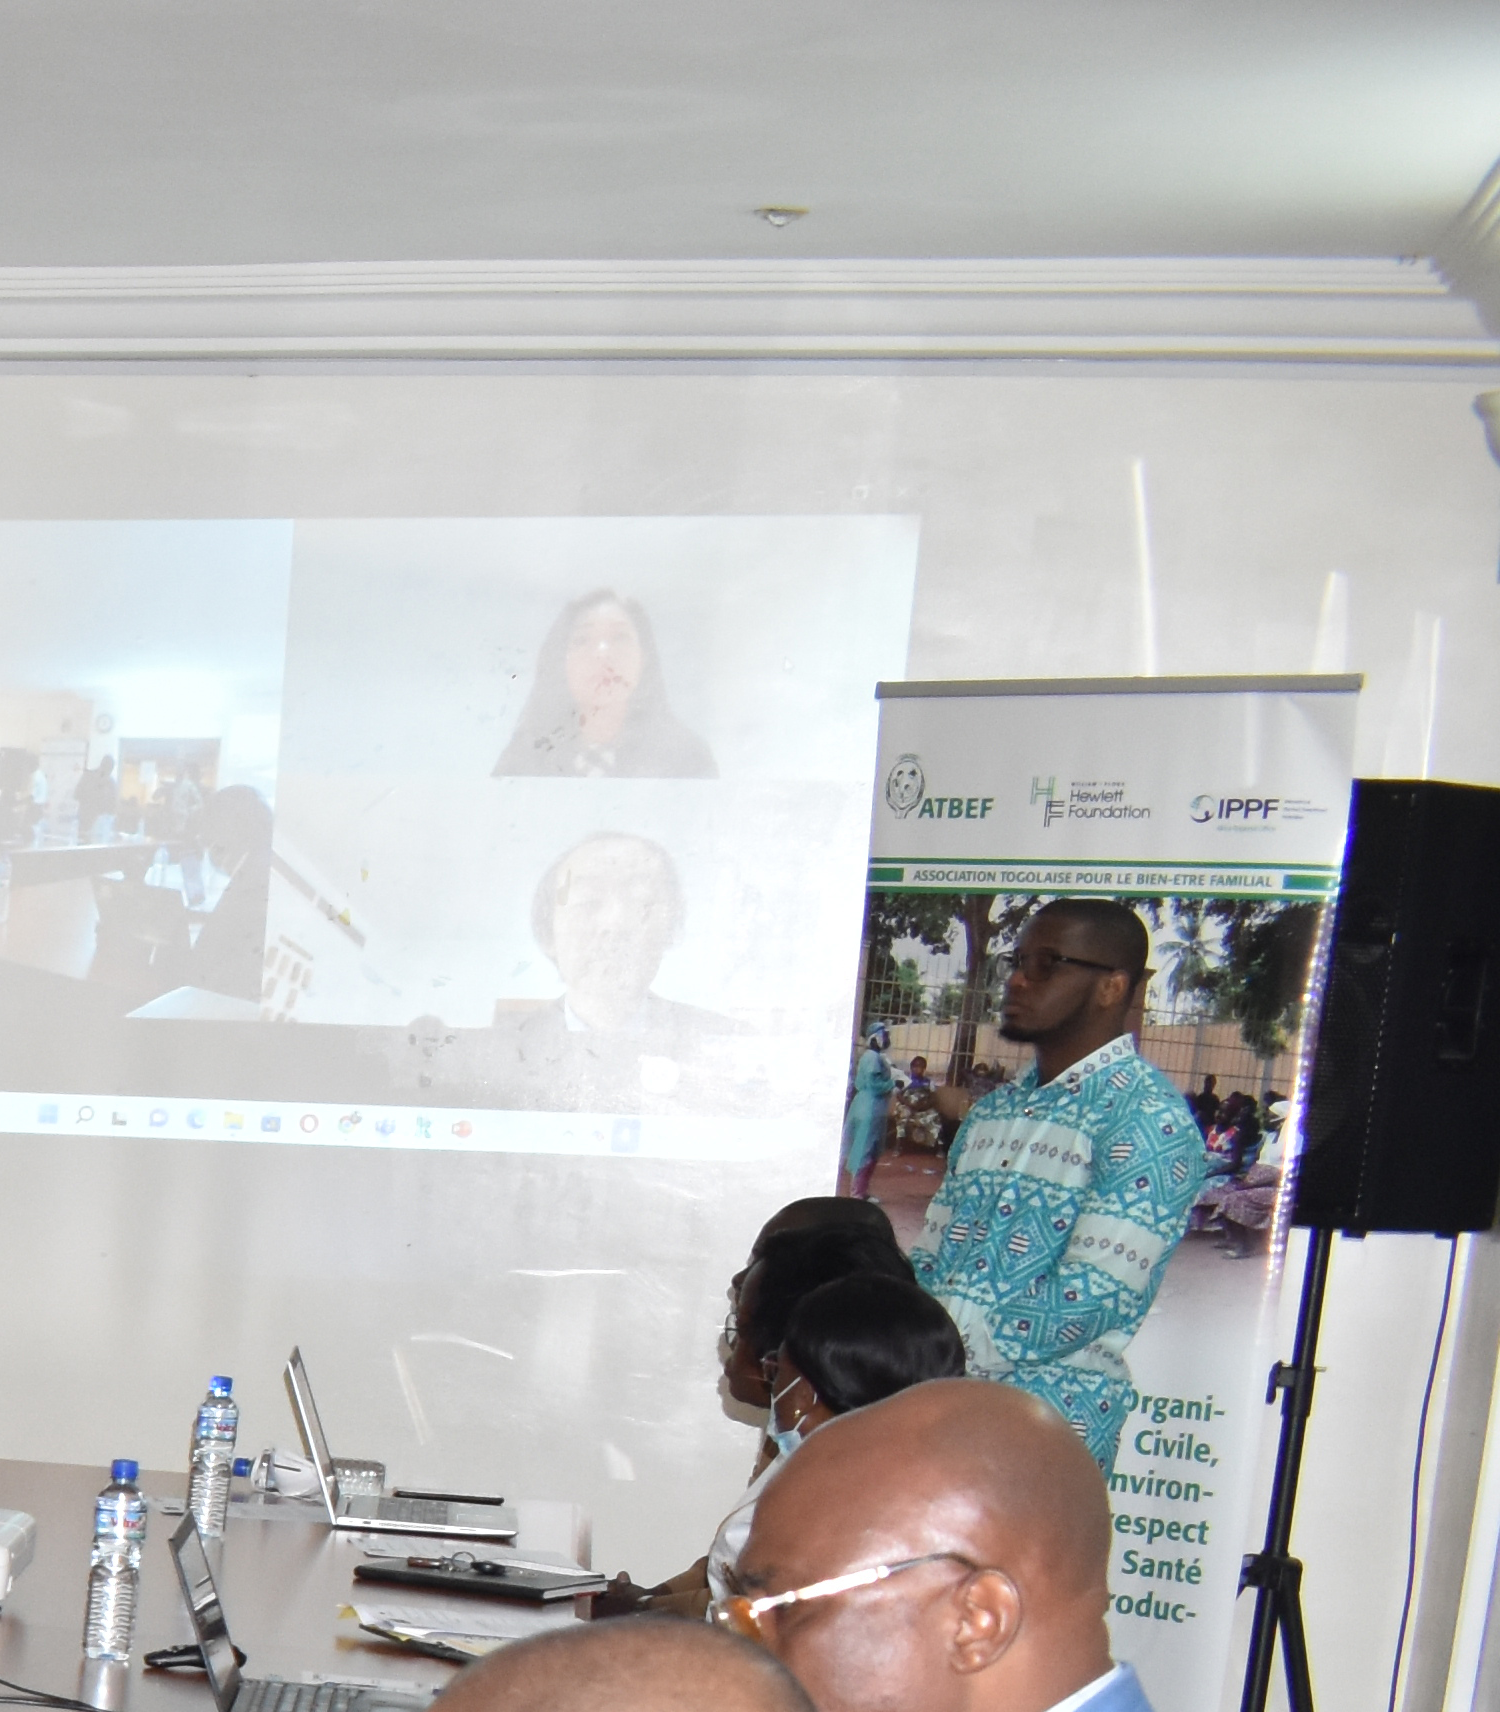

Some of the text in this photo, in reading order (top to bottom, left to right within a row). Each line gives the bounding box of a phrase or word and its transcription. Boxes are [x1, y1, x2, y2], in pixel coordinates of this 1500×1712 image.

[1070, 789, 1124, 803] Hewlett
[917, 797, 995, 819] ATBEF
[1068, 805, 1151, 819] Foundation
[1218, 799, 1280, 819] IPPF
[913, 869, 1272, 887] ASSOCIATION TOGOLAISE POUR LE BIEN-ETRE FAMILIAL
[1134, 1430, 1219, 1467] Civile,
[1109, 1469, 1214, 1503] nviron-
[1121, 1549, 1202, 1585] Santé
